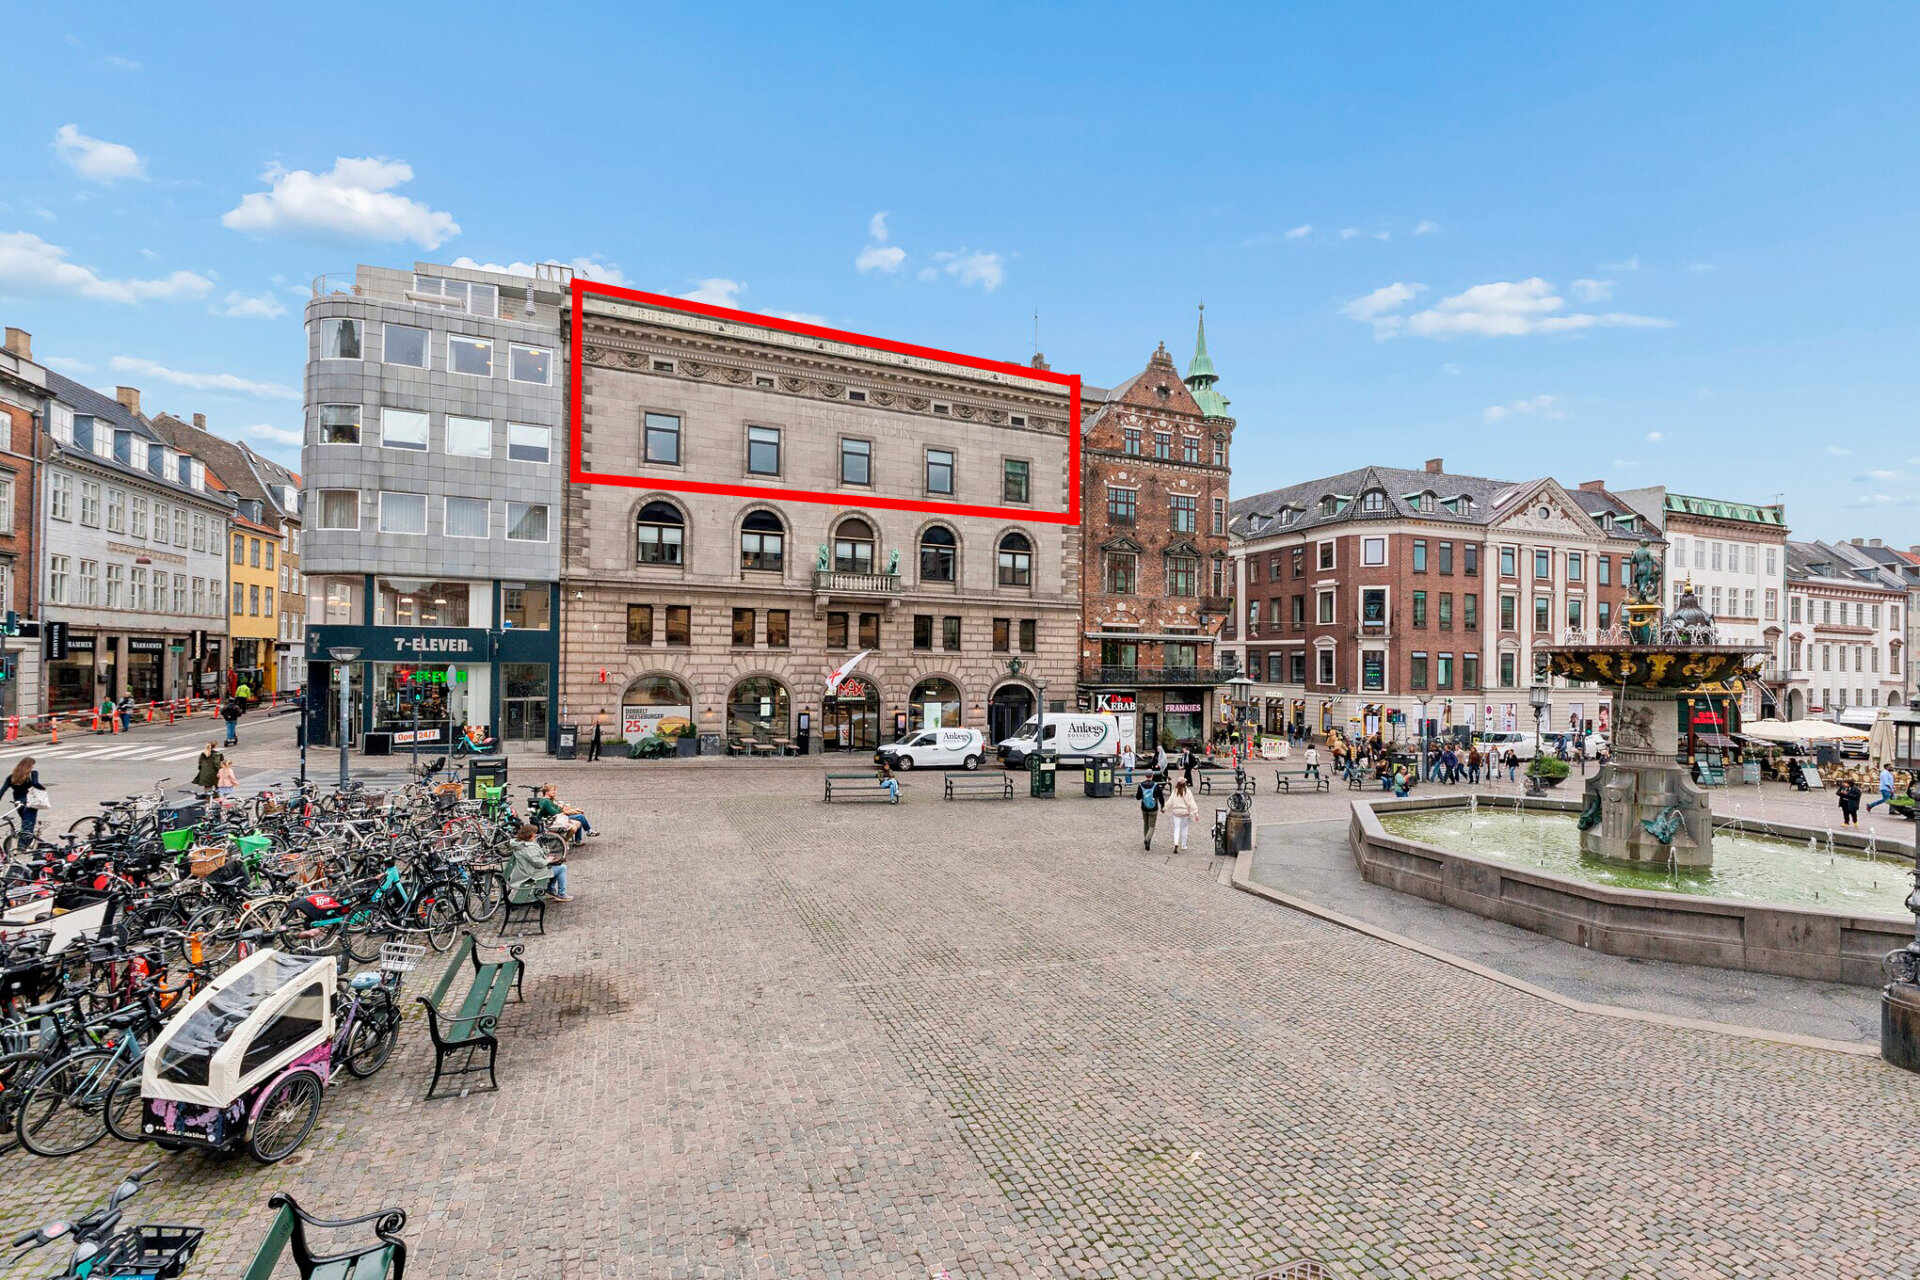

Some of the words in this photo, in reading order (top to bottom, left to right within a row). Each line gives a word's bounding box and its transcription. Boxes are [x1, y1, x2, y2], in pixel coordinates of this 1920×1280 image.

[131, 641, 163, 649] WARHAMMER
[838, 678, 867, 697] MAX
[1096, 694, 1136, 711] KEBAB
[1165, 704, 1201, 713] FRANKIES
[418, 731, 436, 739] 24/7
[1068, 722, 1104, 737] Anlægs
